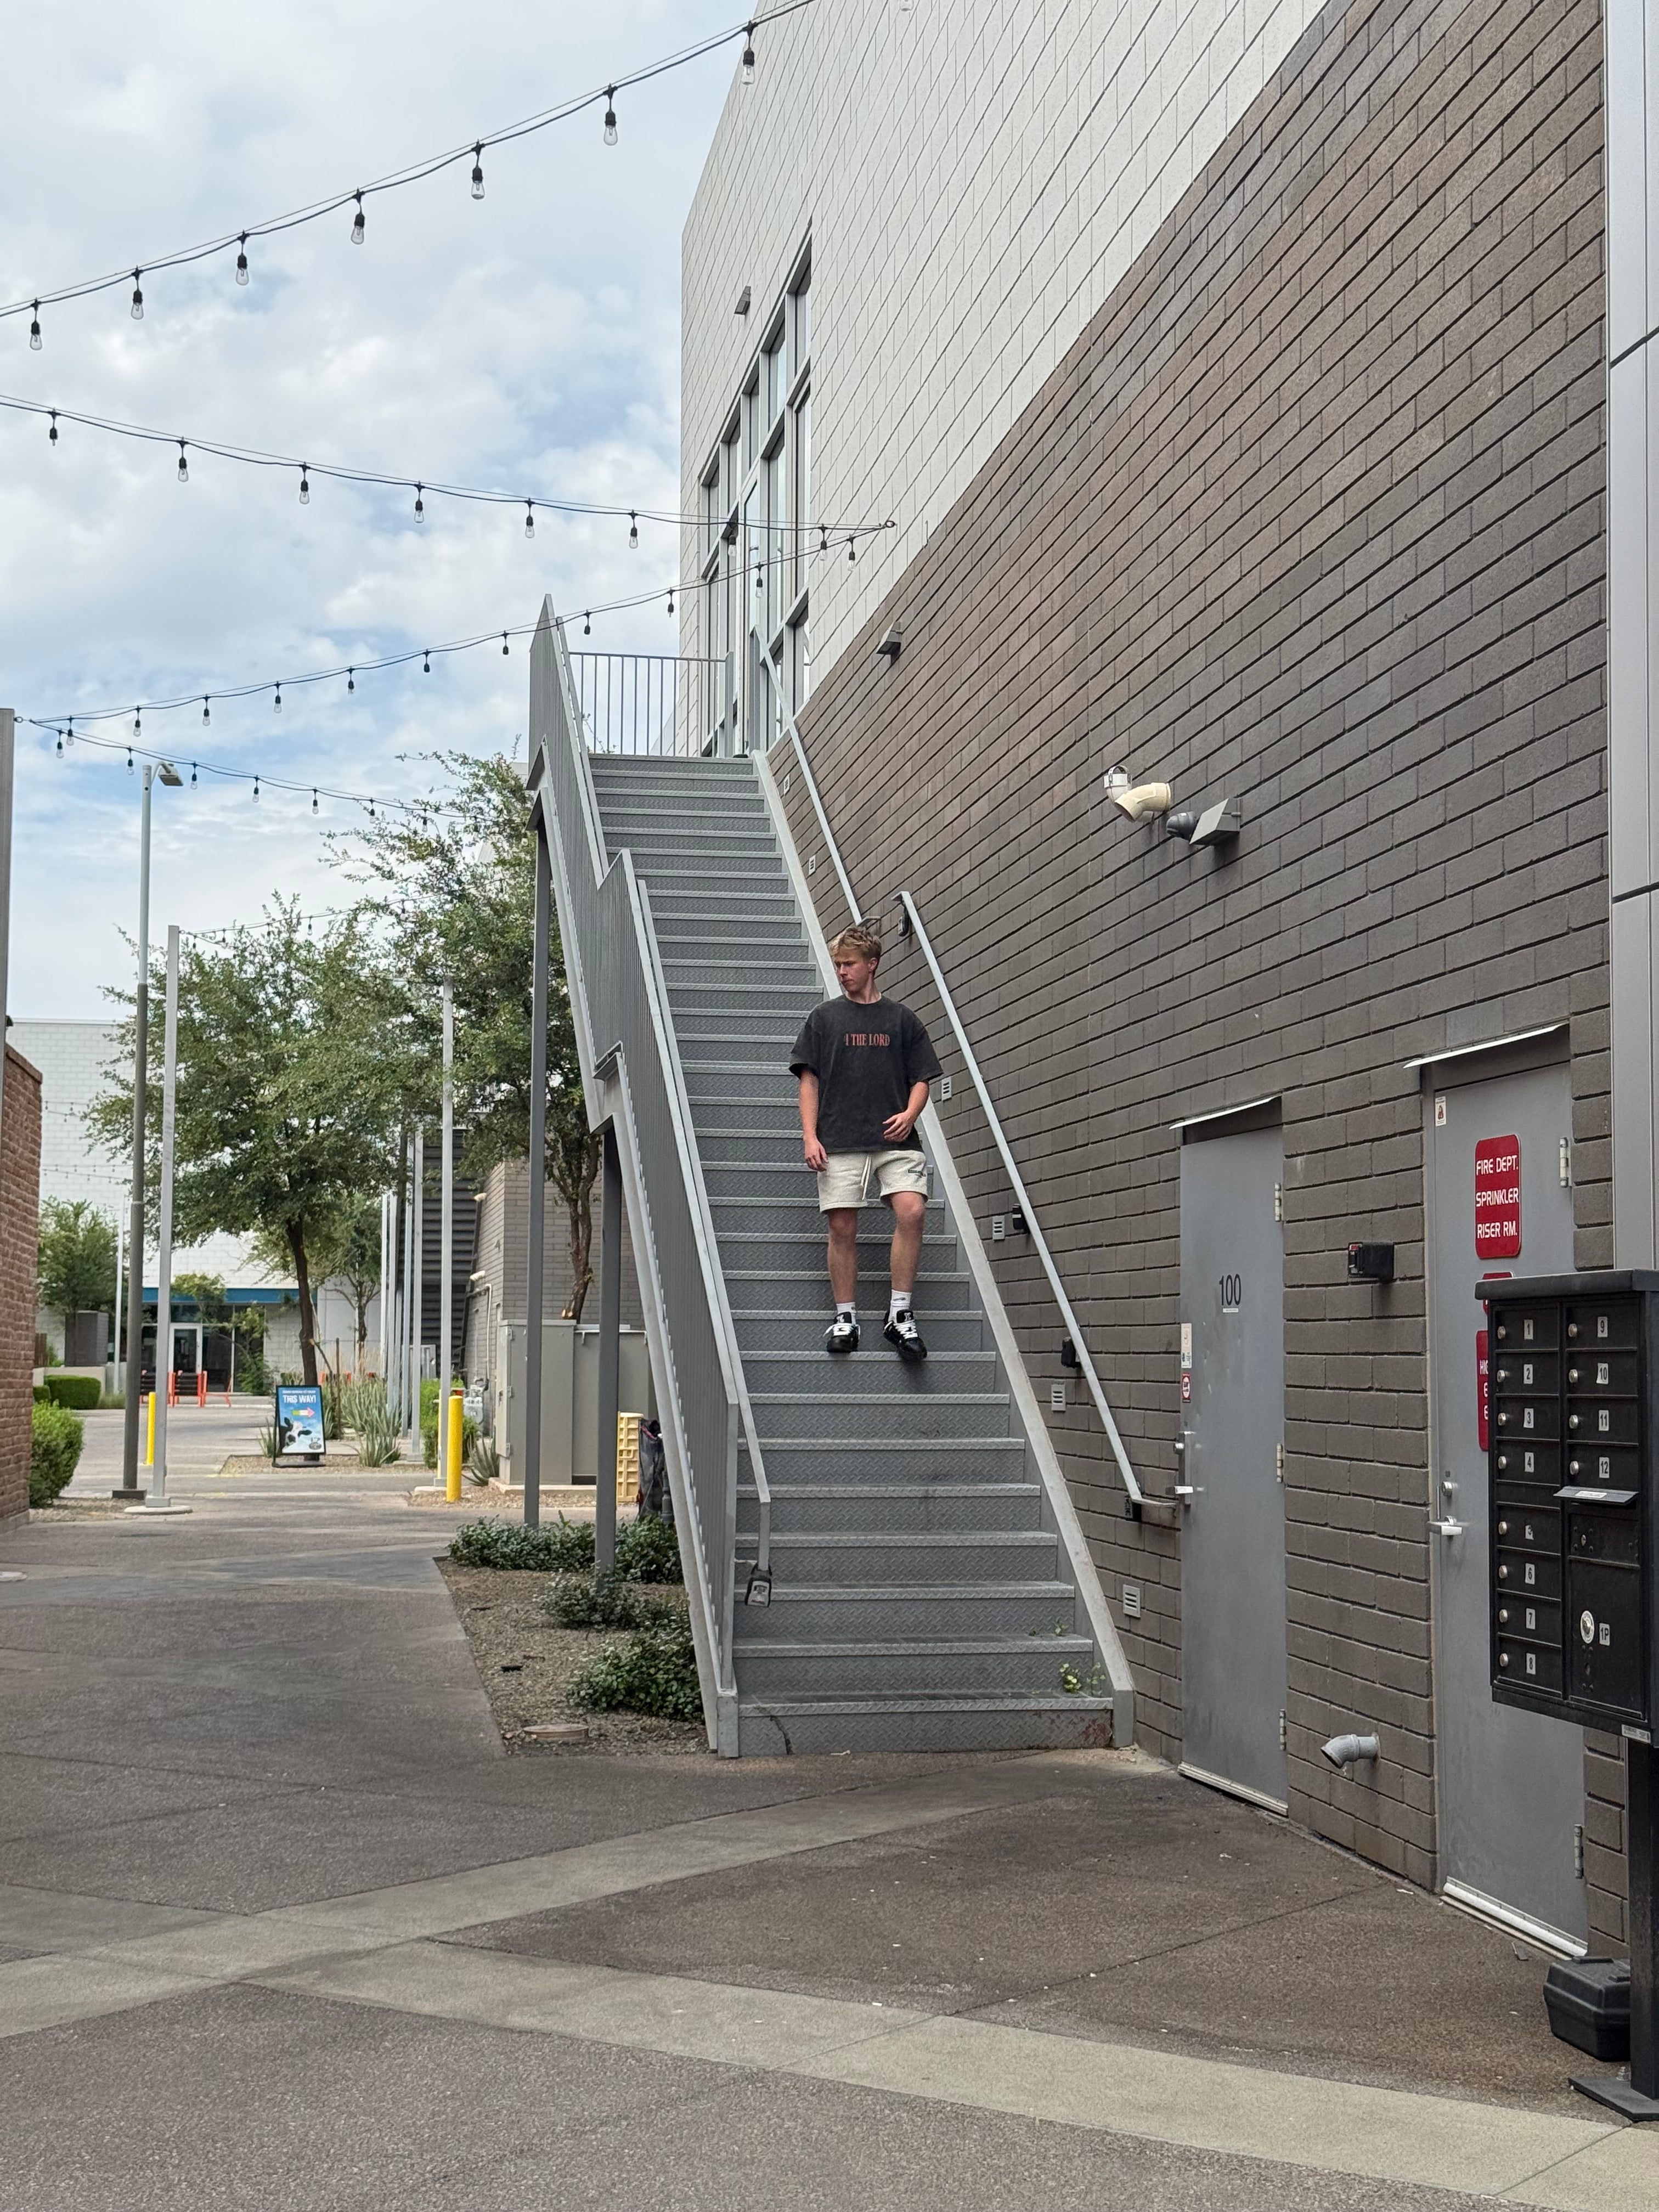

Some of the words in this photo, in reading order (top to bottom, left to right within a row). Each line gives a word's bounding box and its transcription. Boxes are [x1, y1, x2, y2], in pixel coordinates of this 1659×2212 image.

[851, 1034, 867, 1046] THE
[868, 1034, 890, 1046] LORD
[1476, 1159, 1494, 1176] FIRE
[1496, 1155, 1519, 1172] DEPT.
[1476, 1188, 1519, 1207] SPRINKLER
[1477, 1223, 1500, 1239] RISER
[1503, 1221, 1517, 1237] RM.
[1219, 1273, 1242, 1306] 100
[1527, 1323, 1530, 1335] 1
[1600, 1320, 1605, 1333] 9
[1526, 1367, 1531, 1380] 2
[1599, 1367, 1607, 1380] 10
[283, 1395, 298, 1403] THIS
[1527, 1411, 1531, 1424] 3
[1600, 1413, 1607, 1427] 11
[1527, 1455, 1531, 1468] 4
[1600, 1460, 1608, 1474] 12
[1528, 1567, 1532, 1580] 6
[1528, 1612, 1533, 1624] 7
[1600, 1627, 1609, 1640] 1P
[1529, 1657, 1533, 1670] 8
